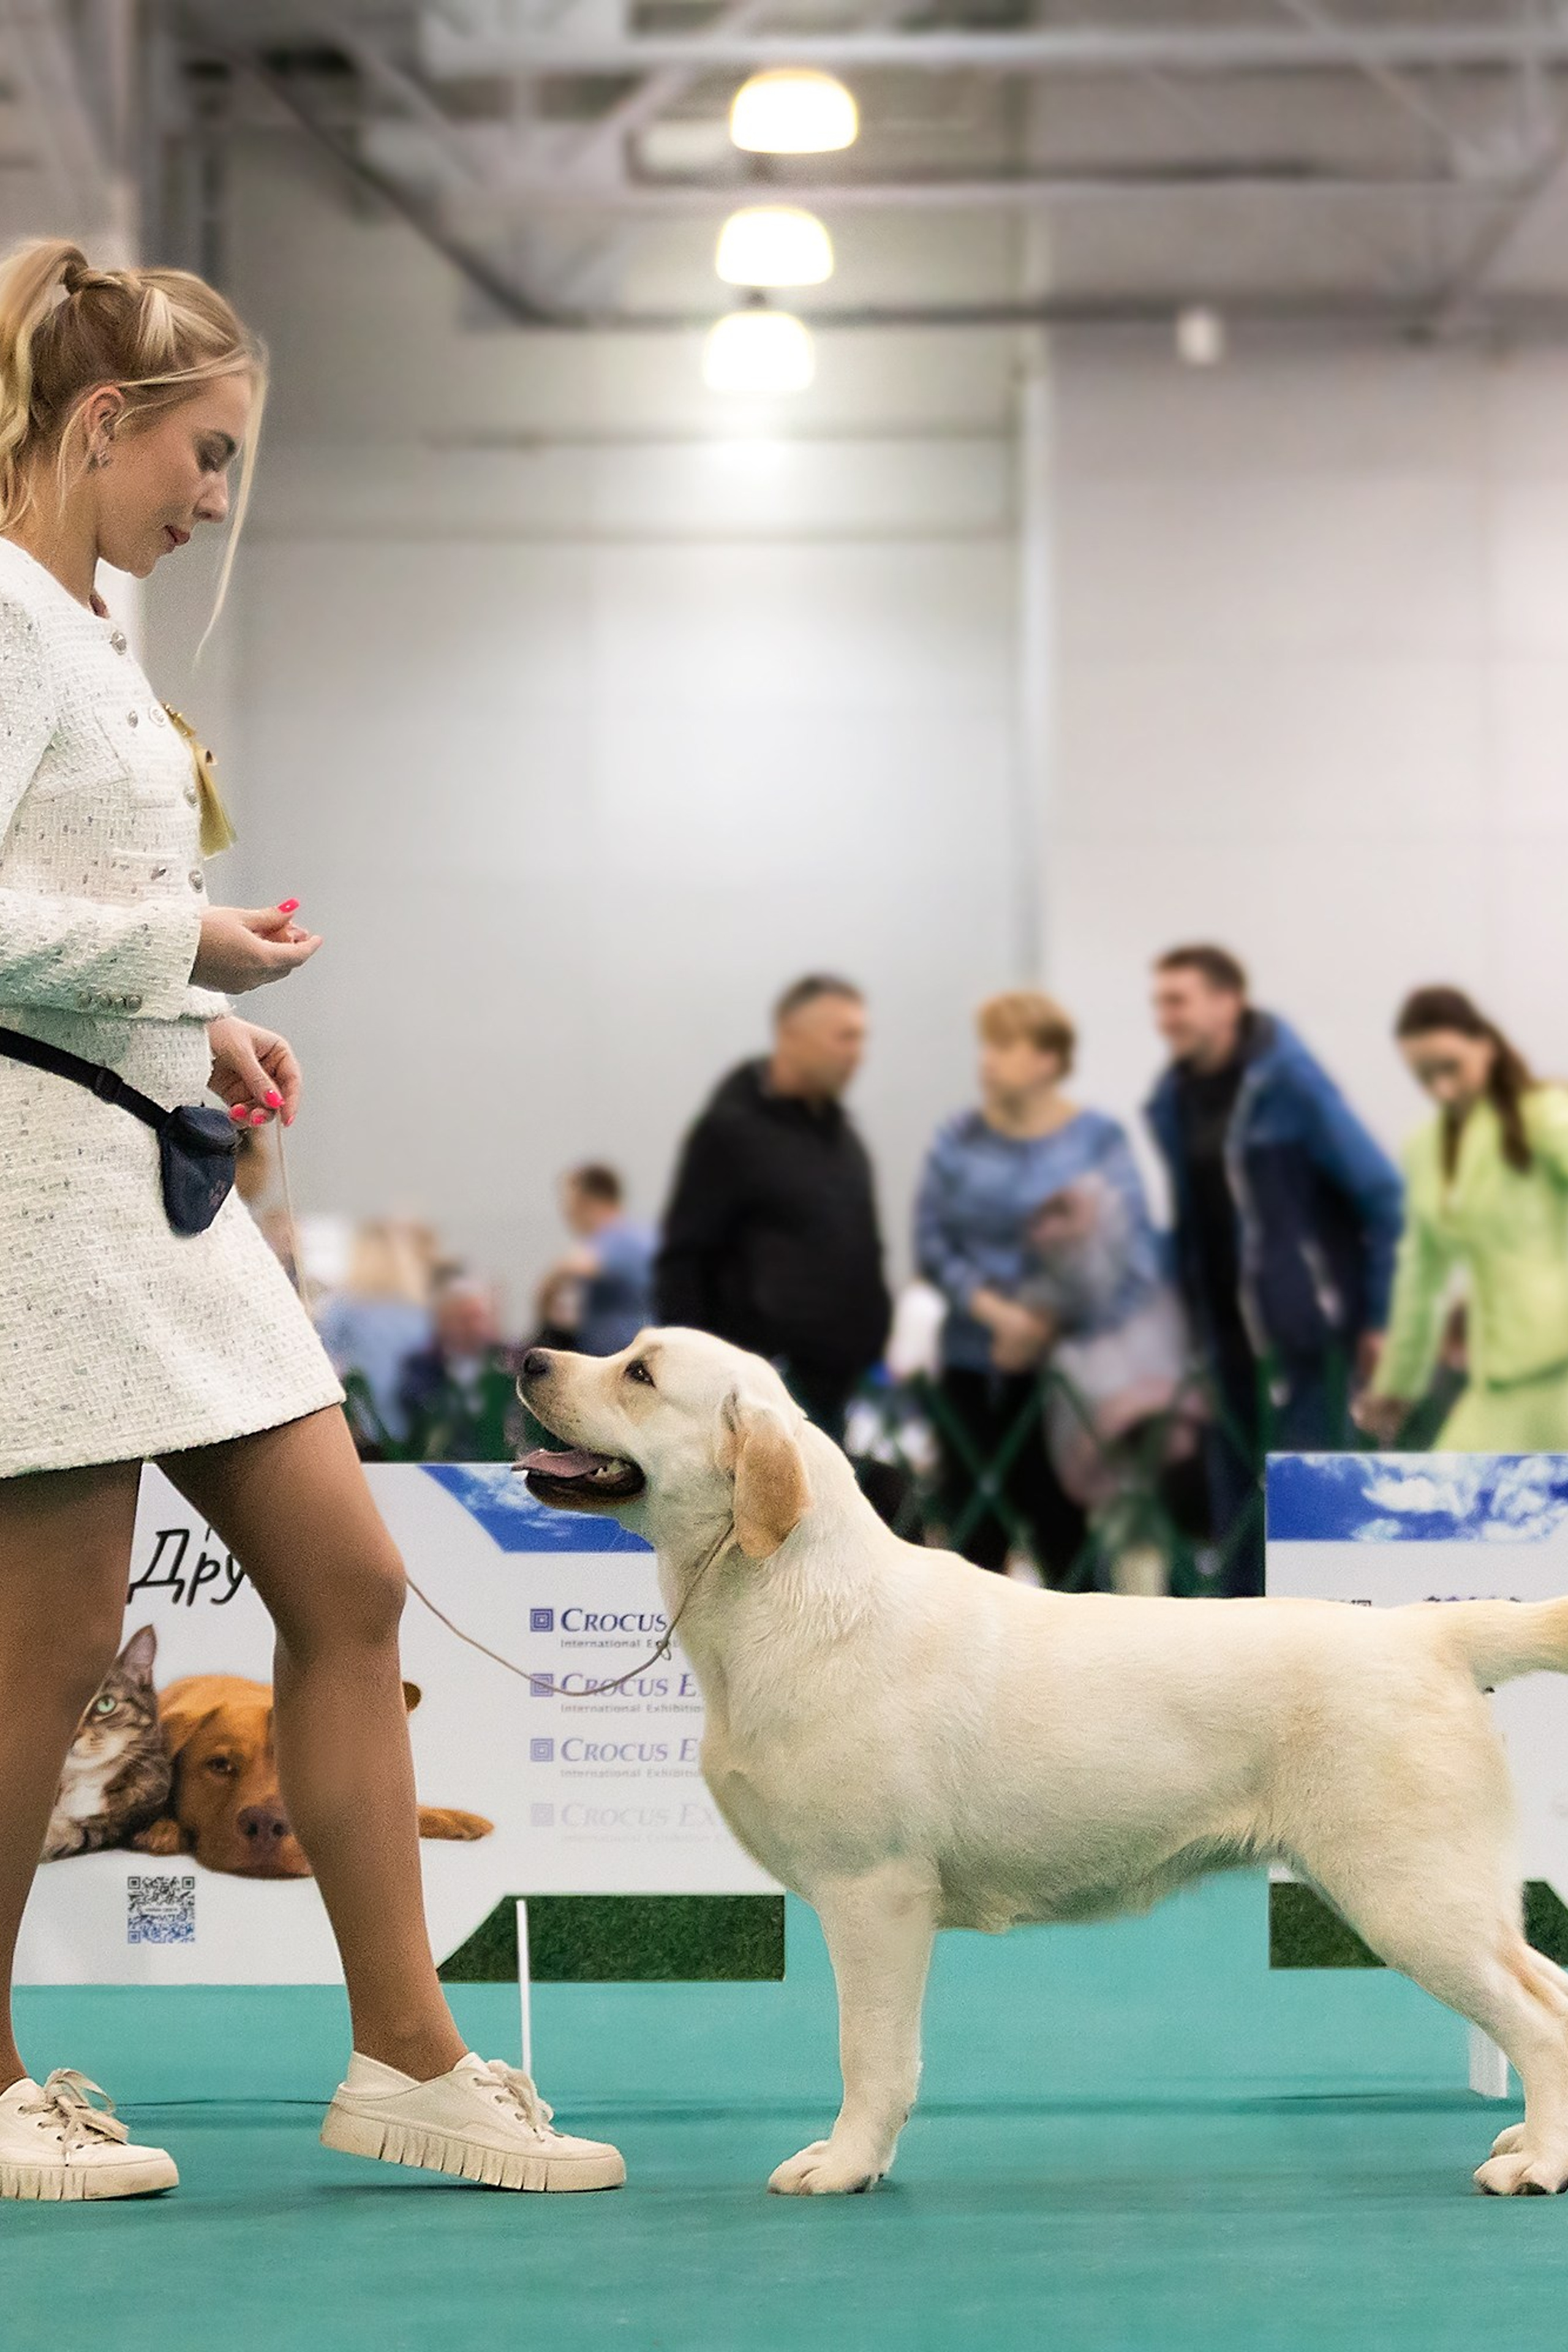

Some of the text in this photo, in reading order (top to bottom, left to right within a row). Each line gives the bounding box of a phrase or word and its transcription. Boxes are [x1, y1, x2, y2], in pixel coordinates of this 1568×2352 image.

[127, 1528, 244, 1607] Дру
[560, 1608, 668, 1632] CROCUS
[560, 1639, 639, 1648] International
[561, 1673, 668, 1697] CROCUS
[561, 1704, 640, 1713] International
[560, 1738, 668, 1762] CROCUS
[561, 1803, 669, 1826] CROCUS
